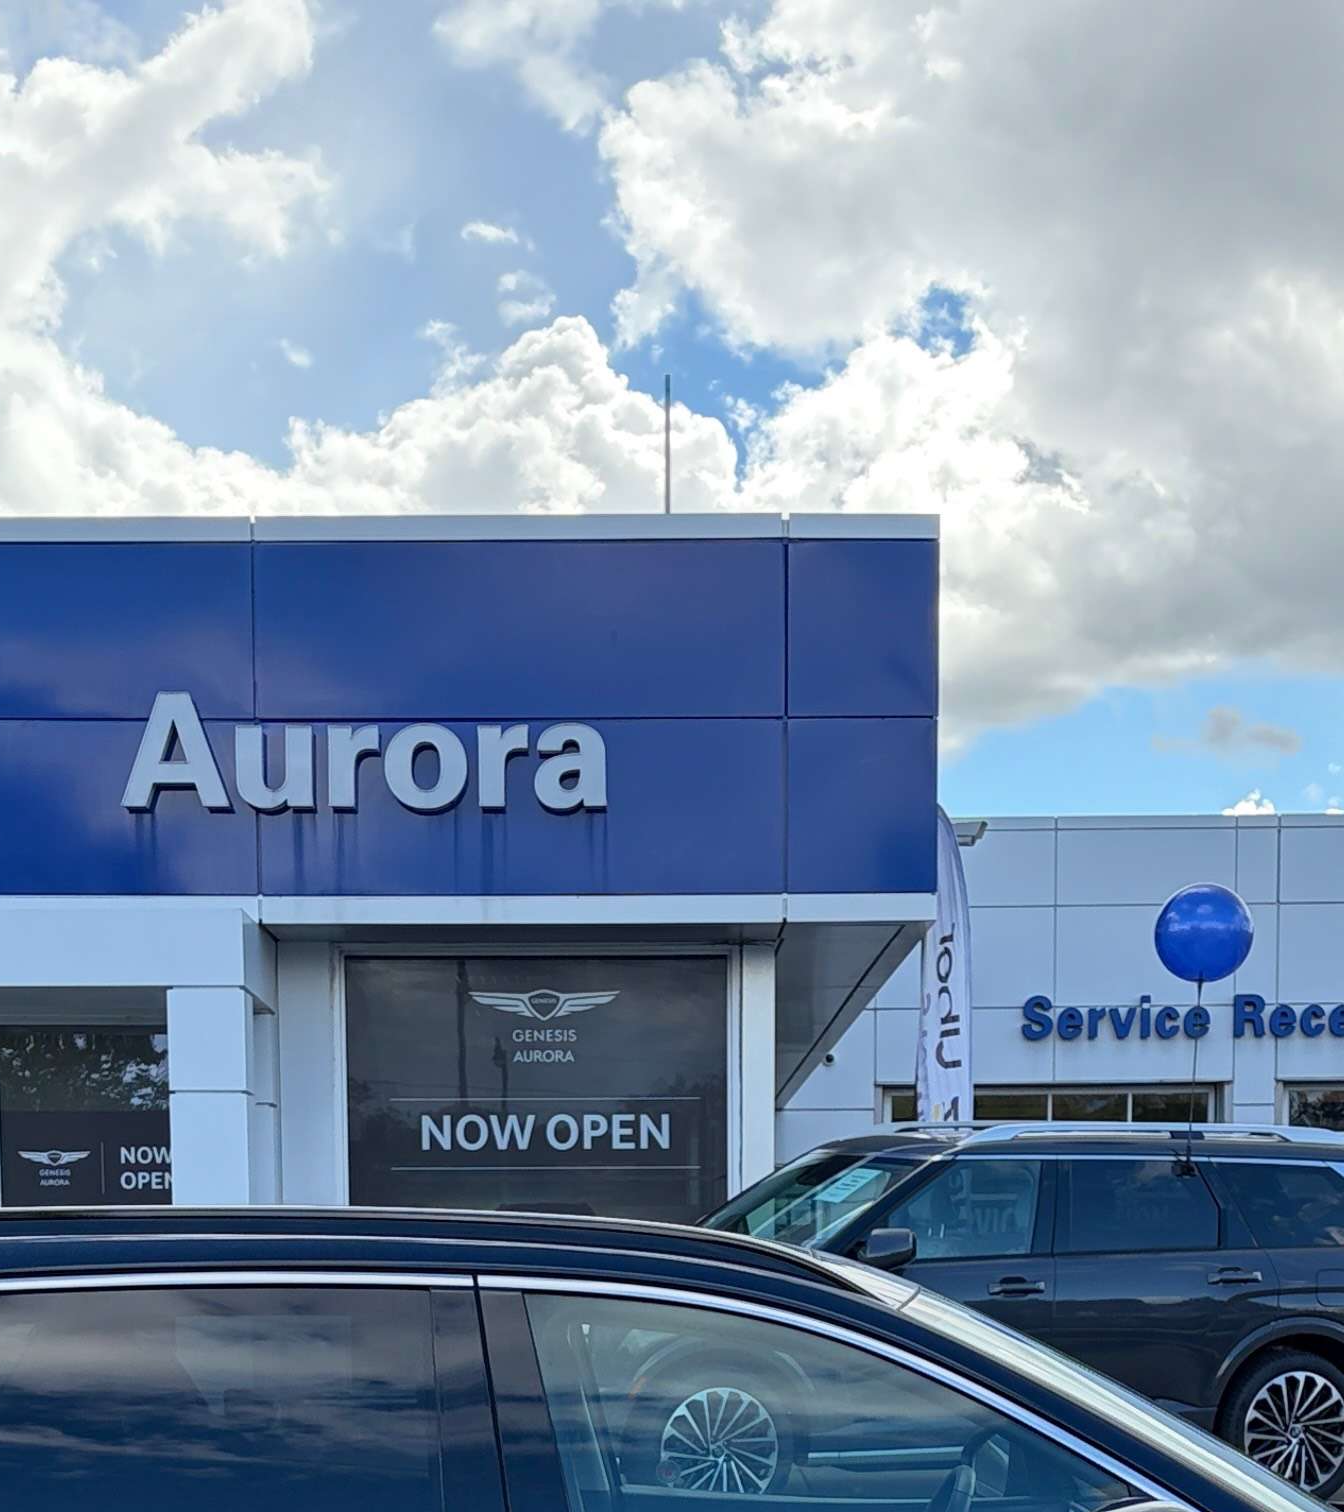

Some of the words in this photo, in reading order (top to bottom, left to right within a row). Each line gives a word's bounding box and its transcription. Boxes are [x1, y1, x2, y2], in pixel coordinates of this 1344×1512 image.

[120, 691, 608, 814] Aurora
[1021, 995, 1211, 1041] Service
[512, 1029, 577, 1042] GENESIS
[512, 1050, 575, 1063] AURORA
[420, 1113, 536, 1151] NOW
[546, 1112, 671, 1151] OPEN
[120, 1146, 172, 1164] NOW
[39, 1168, 72, 1177] GENESIS
[39, 1179, 71, 1187] AURORA
